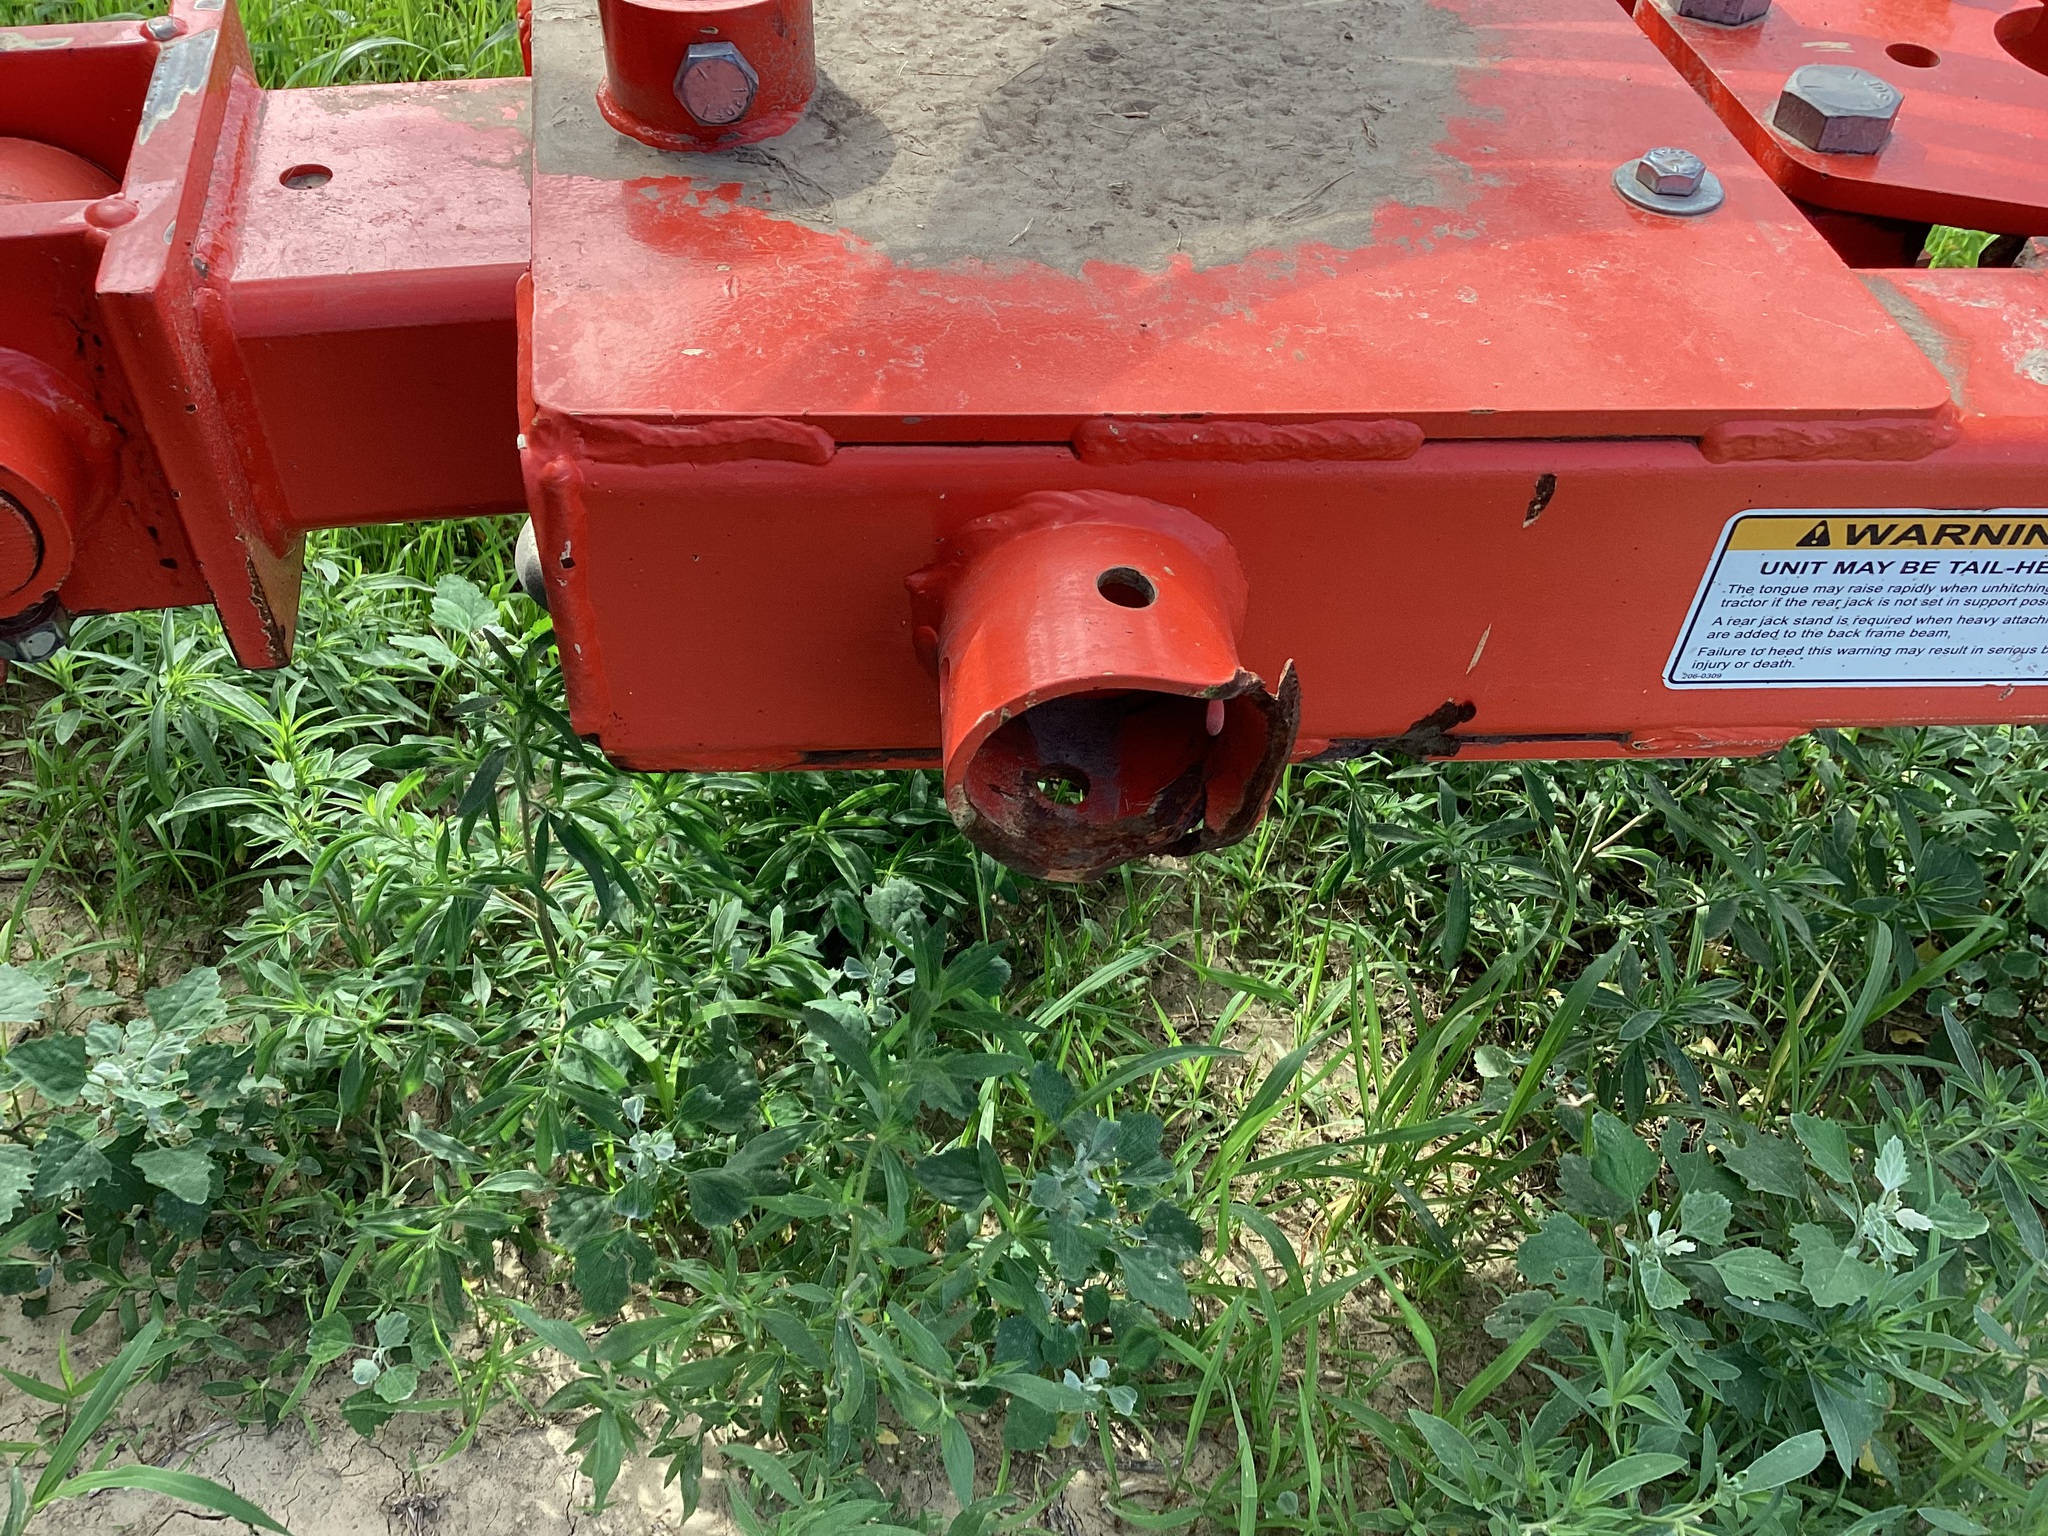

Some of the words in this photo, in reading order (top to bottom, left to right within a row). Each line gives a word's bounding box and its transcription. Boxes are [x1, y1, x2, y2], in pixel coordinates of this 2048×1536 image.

[1846, 524, 2048, 545] WARNIN
[1760, 561, 1828, 575] UNIT
[1832, 561, 1896, 574] MAY
[1900, 561, 1940, 574] BE
[1950, 561, 2048, 574] TAIL-HE
[1728, 584, 1754, 594] The
[1760, 585, 1808, 595] tongue
[1813, 585, 1844, 595] may
[1848, 584, 1883, 593] raise
[1887, 584, 1936, 595] rapidly
[1940, 584, 1977, 593] when
[1721, 598, 1768, 607] tractor
[1771, 598, 1783, 607] if
[1784, 598, 1807, 607] the
[1811, 598, 1842, 607] rear
[1842, 597, 1874, 608] jack
[1878, 597, 1890, 606] is
[1894, 597, 1917, 606] not
[1921, 597, 1944, 606] set
[1946, 597, 1960, 606] in
[1963, 597, 2017, 608] support
[1712, 616, 1723, 626] A
[1727, 616, 1755, 626] rear
[1758, 616, 1789, 627] jack
[1793, 616, 1833, 625] stand
[1837, 616, 1848, 625] is
[1852, 615, 1912, 626] required
[1916, 615, 1952, 625] when
[1957, 615, 1999, 626] heavy
[1707, 631, 1730, 639] are
[1734, 629, 1779, 639] added
[1783, 630, 1796, 638] to
[1801, 629, 1823, 638] the
[1827, 629, 1861, 638] back
[1865, 629, 1905, 638] frame
[1697, 647, 1746, 656] Failure
[1751, 647, 1764, 656] to
[1768, 646, 1804, 656] heed
[1807, 646, 1832, 655] this
[1837, 646, 1891, 657] warning
[1895, 646, 1925, 656] may
[1929, 645, 1968, 654] result
[1970, 646, 1983, 654] in
[1987, 645, 2038, 654] serious
[1691, 659, 1730, 671] injury
[1734, 661, 1749, 669] or
[1753, 659, 1795, 668] death.
